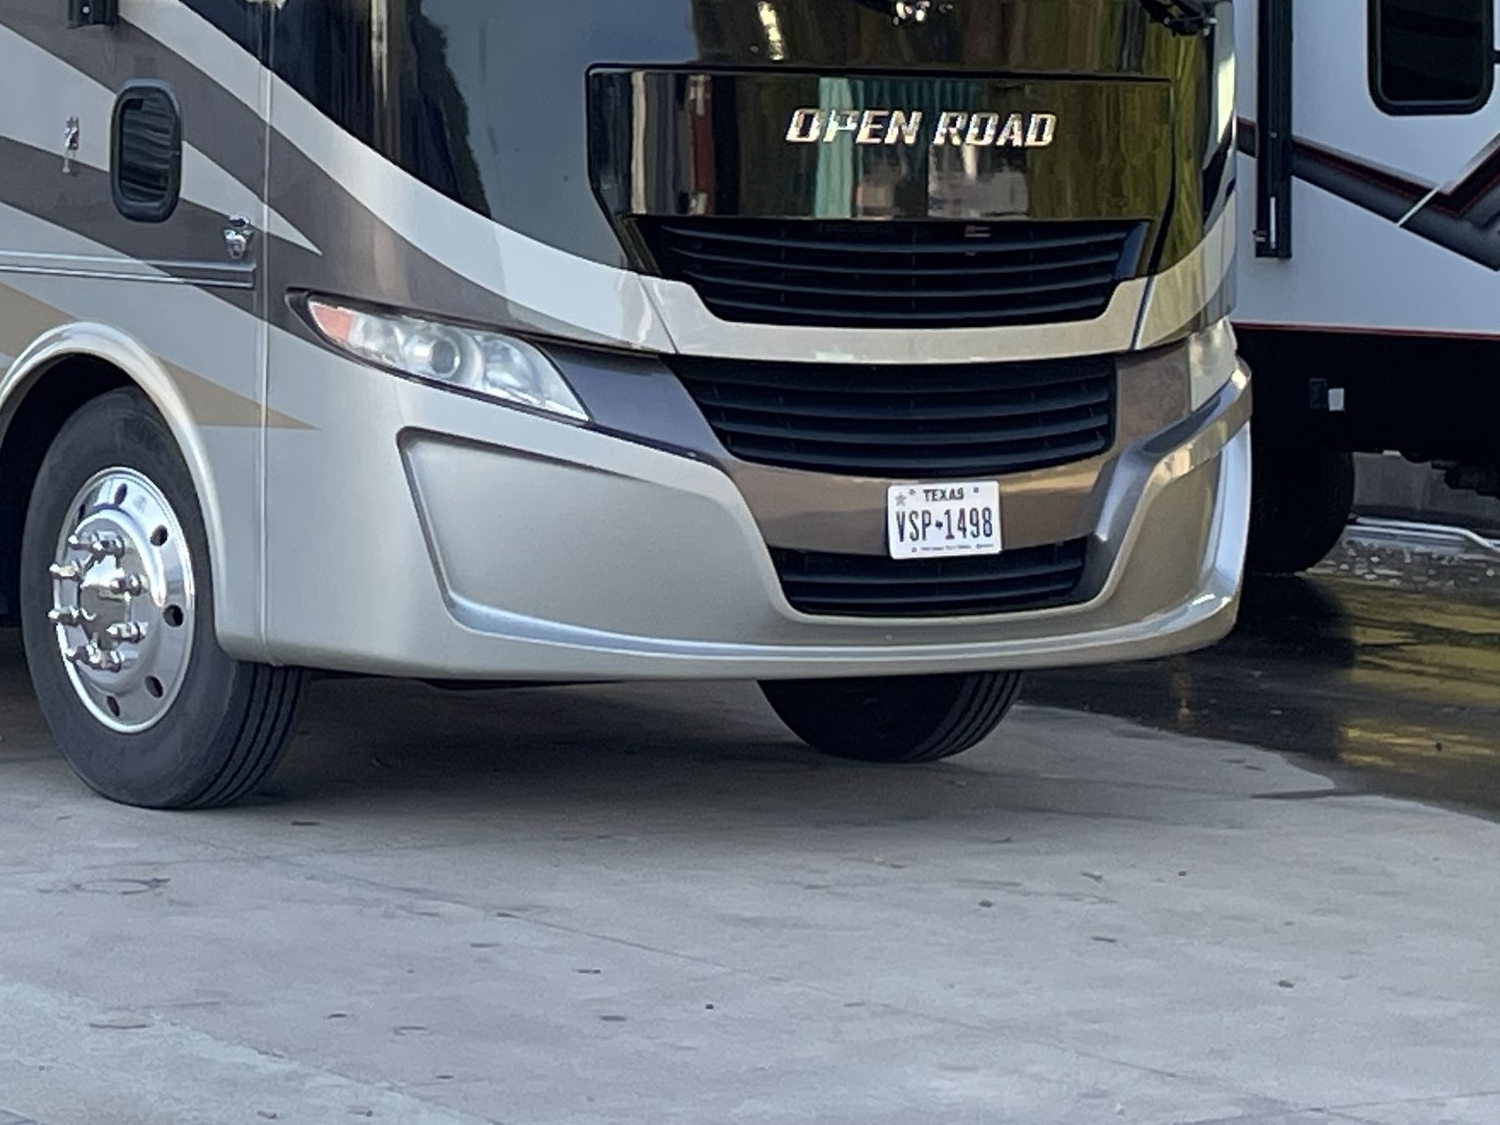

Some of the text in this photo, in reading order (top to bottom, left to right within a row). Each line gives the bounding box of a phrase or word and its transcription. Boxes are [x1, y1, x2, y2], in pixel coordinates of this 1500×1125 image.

[785, 107, 1057, 147] OPEN ROAD
[923, 487, 965, 502] TEXAS
